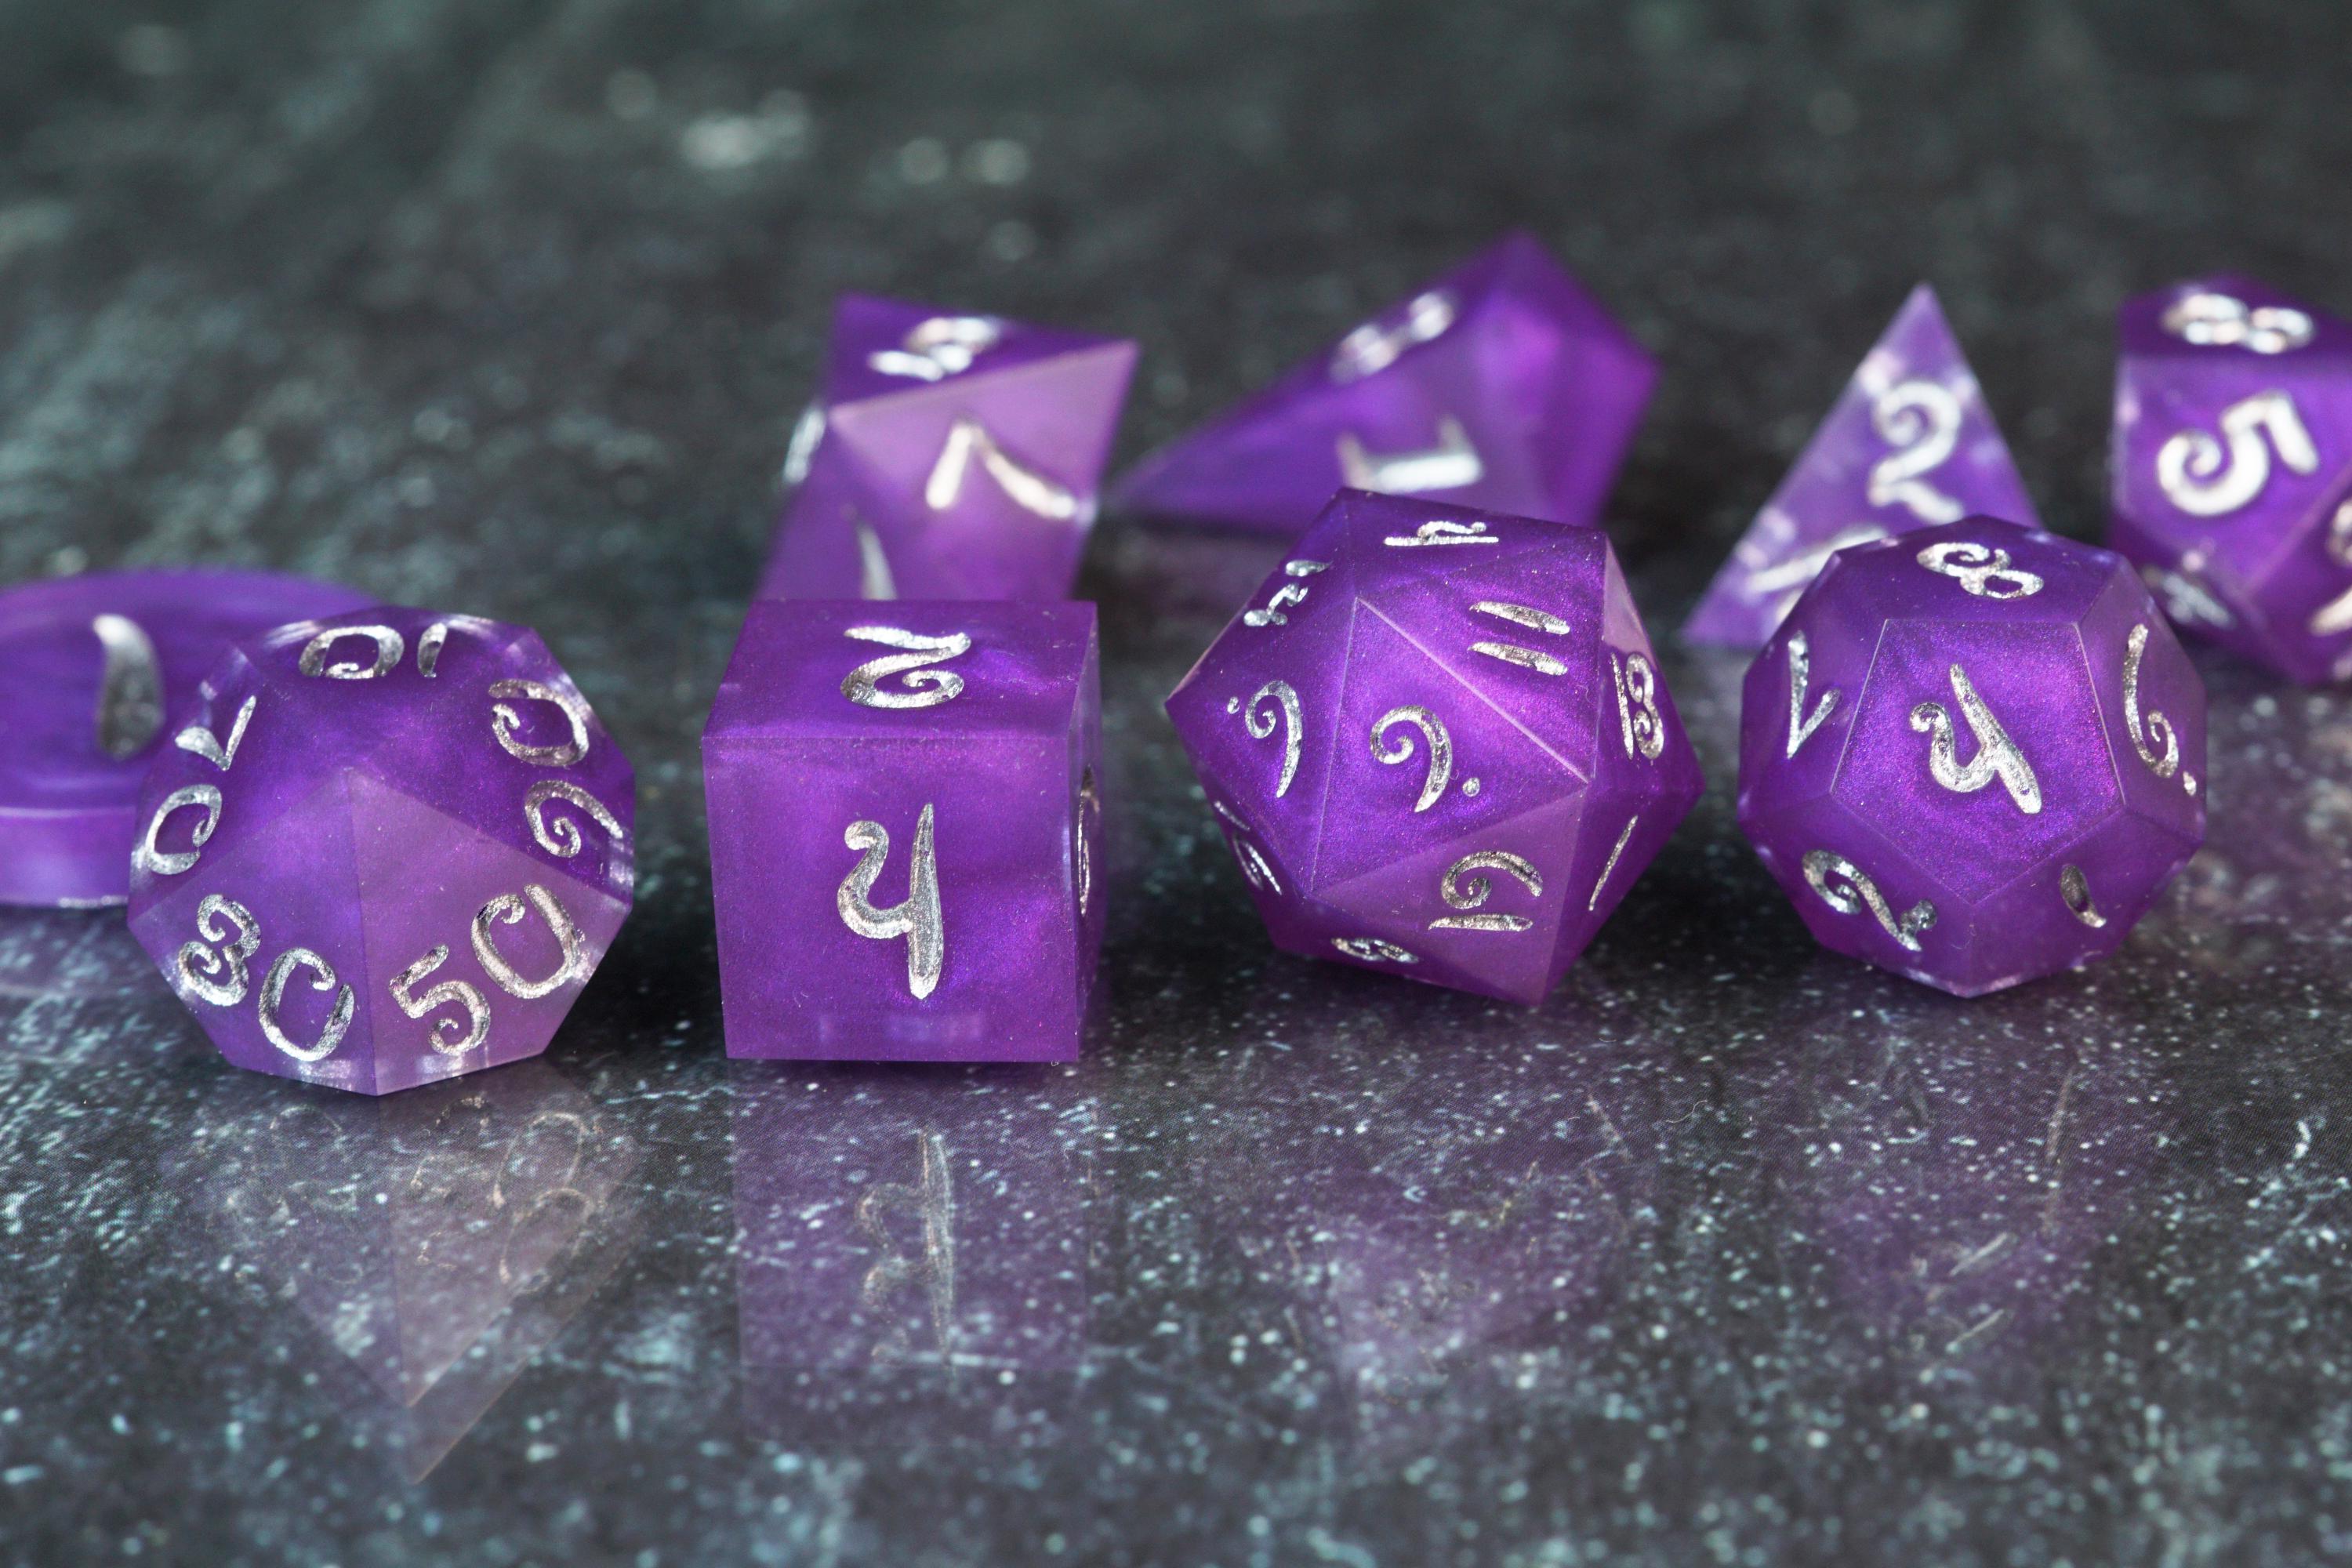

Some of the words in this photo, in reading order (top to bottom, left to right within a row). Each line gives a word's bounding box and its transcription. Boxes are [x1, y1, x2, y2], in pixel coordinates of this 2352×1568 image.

[1870, 379, 1964, 527] 2
[2156, 388, 2321, 517] 5
[1915, 542, 2045, 600] 8
[298, 622, 448, 680] 10
[840, 625, 971, 710] 2
[1468, 600, 1570, 676] 11
[1908, 662, 2043, 815] 4
[837, 801, 944, 1000] 4
[1427, 850, 1544, 932] 19
[177, 894, 355, 1062] 30
[389, 883, 588, 1056] 50
